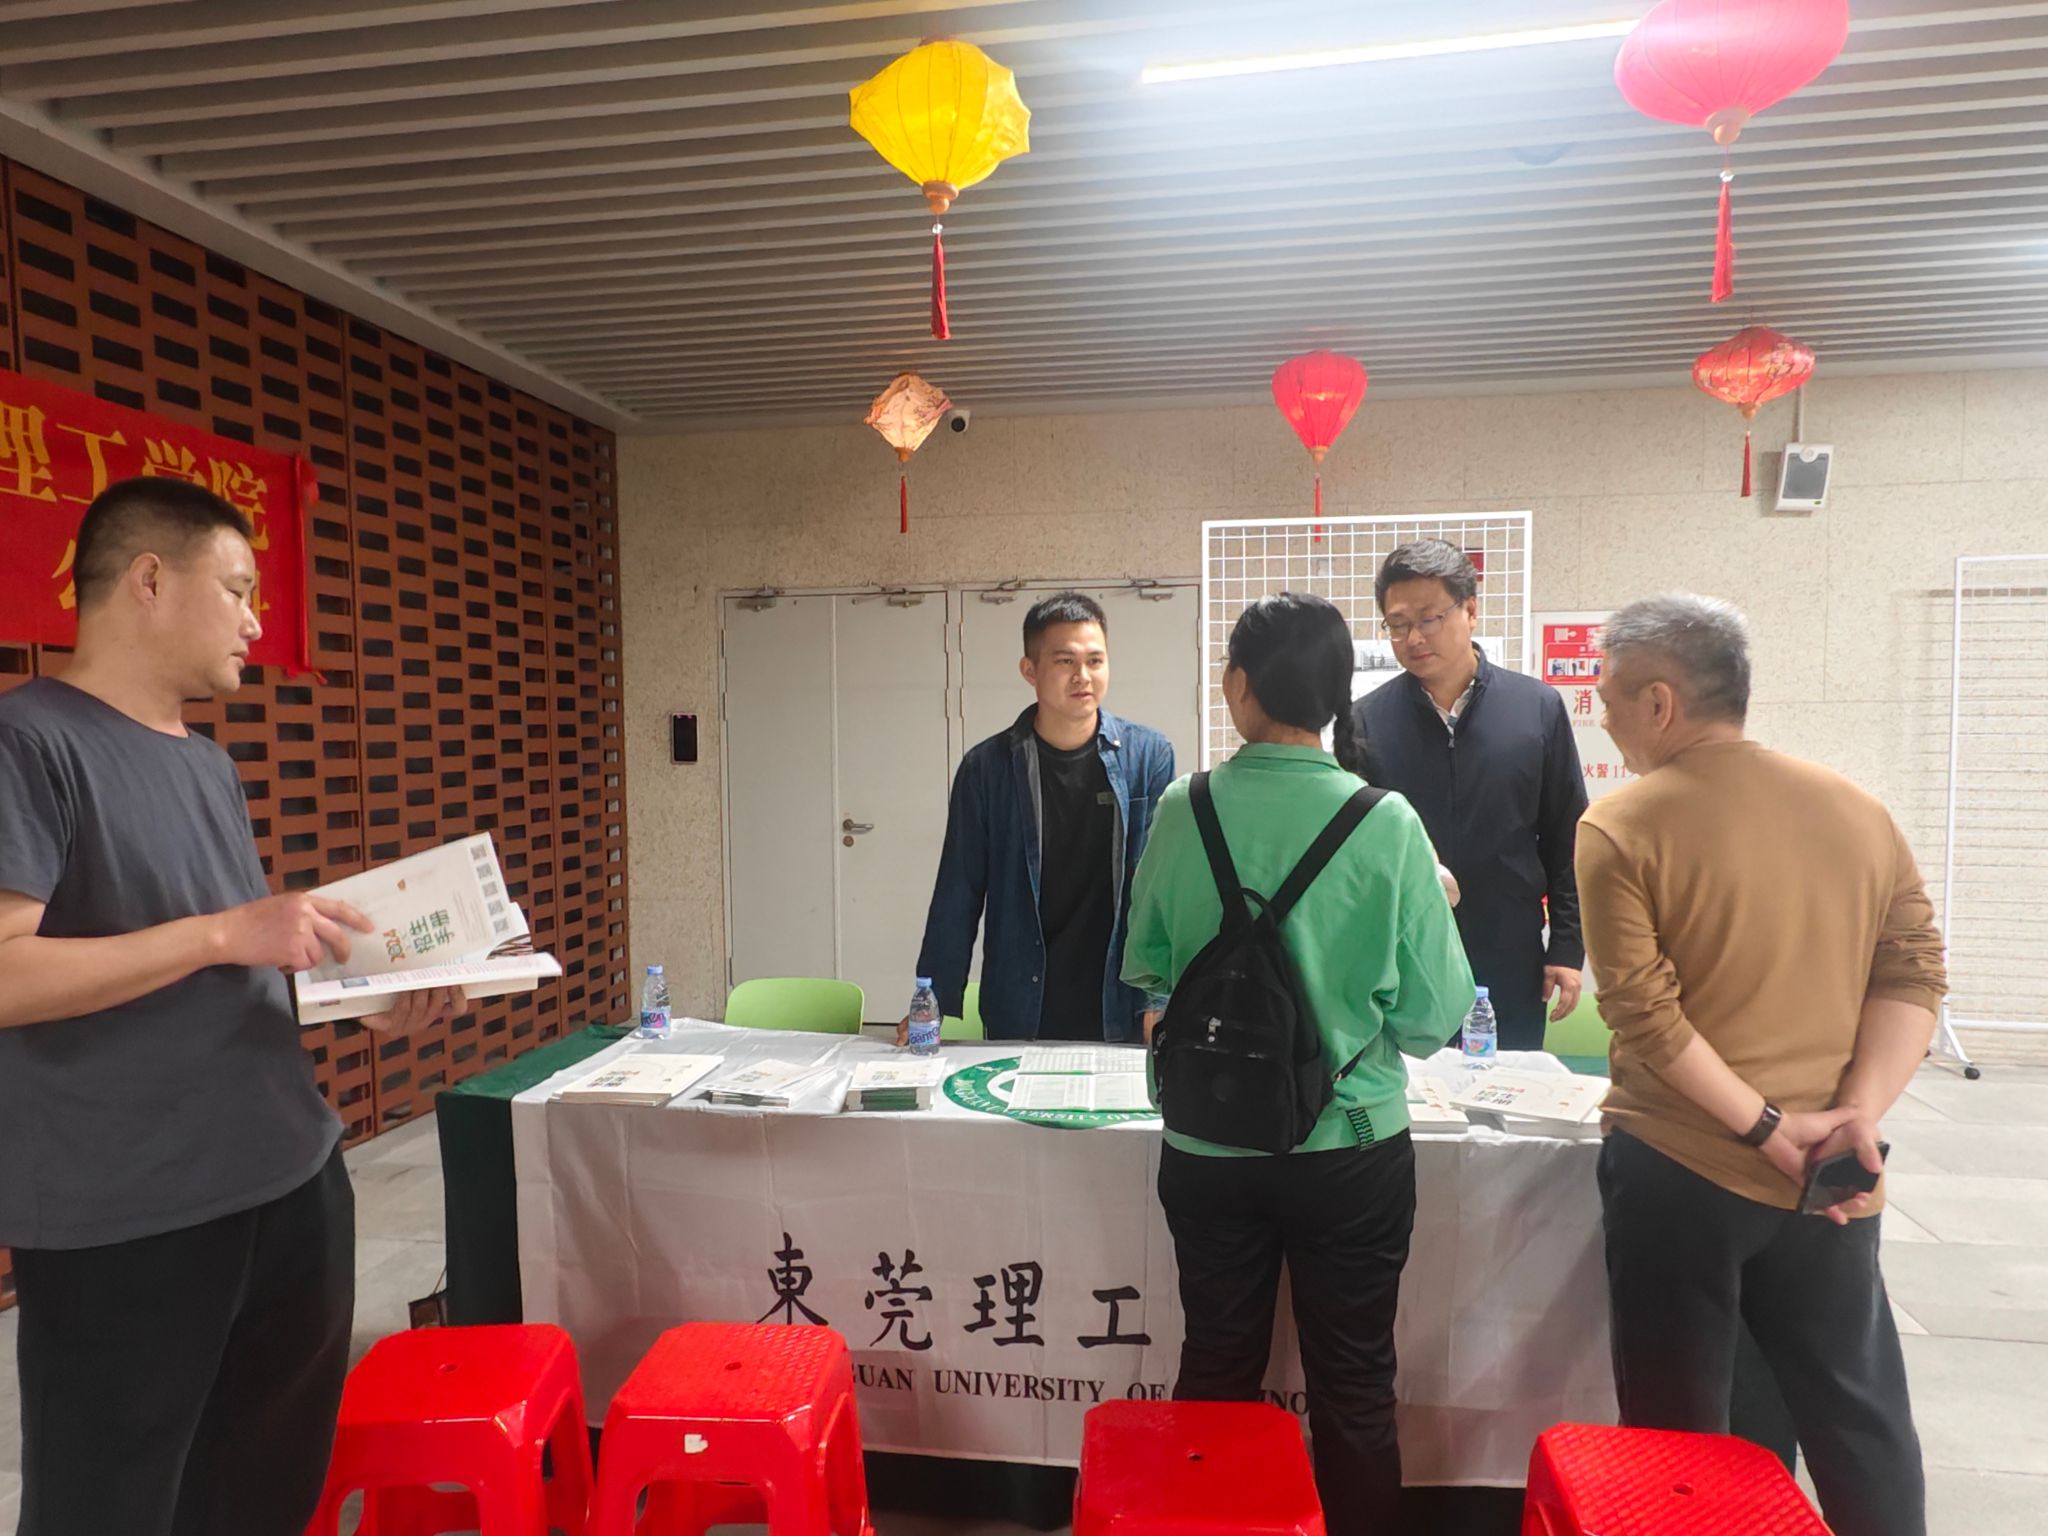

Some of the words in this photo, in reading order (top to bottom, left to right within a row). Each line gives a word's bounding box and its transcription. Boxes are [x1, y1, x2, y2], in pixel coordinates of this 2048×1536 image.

[1573, 689, 1592, 715] 消
[1583, 763, 1609, 779] 火警
[1613, 765, 1636, 779] 11
[755, 1231, 1152, 1350] 東莞理工
[851, 1362, 914, 1392] UAN
[933, 1369, 1106, 1402] UNIVERSITY
[1126, 1382, 1166, 1401] OF
